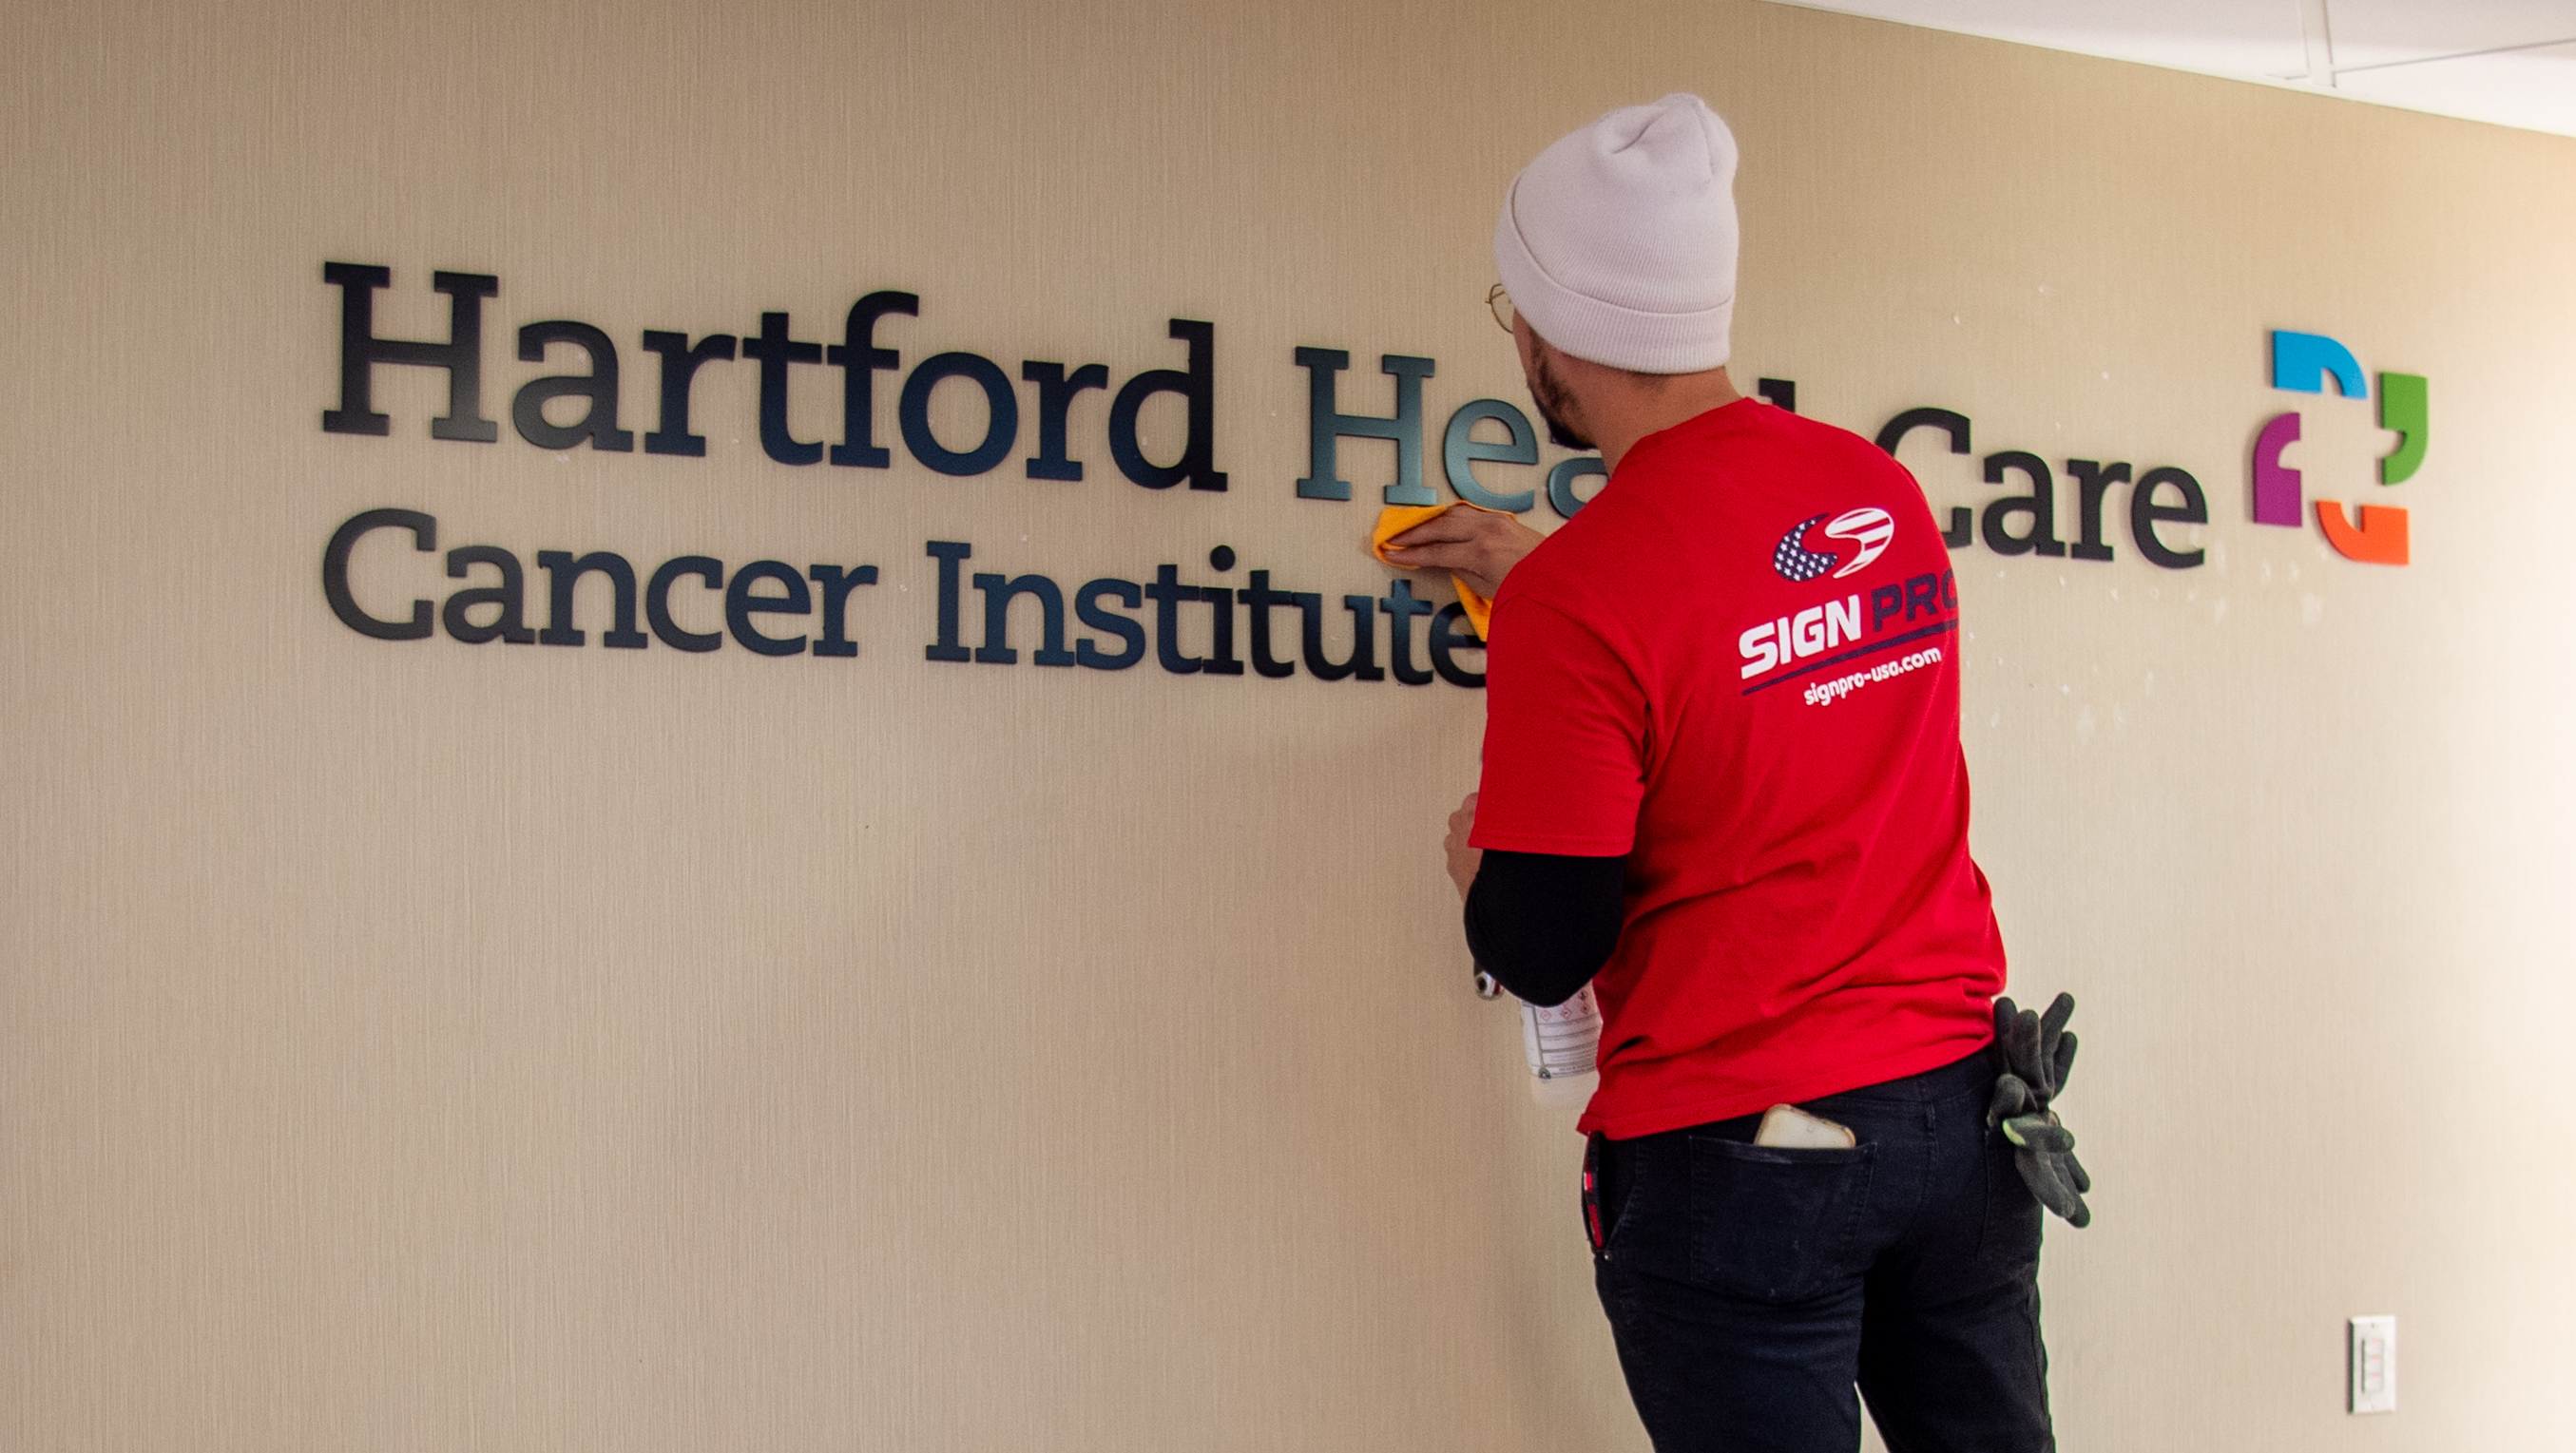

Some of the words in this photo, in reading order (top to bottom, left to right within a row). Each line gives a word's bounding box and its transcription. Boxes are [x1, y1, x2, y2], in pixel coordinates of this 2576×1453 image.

[322, 261, 1228, 492] Hartford
[322, 507, 879, 658] Cancer
[925, 540, 1488, 689] Institute
[1739, 594, 1862, 680] SIGN
[1803, 647, 1943, 706] signpro-usa.com
